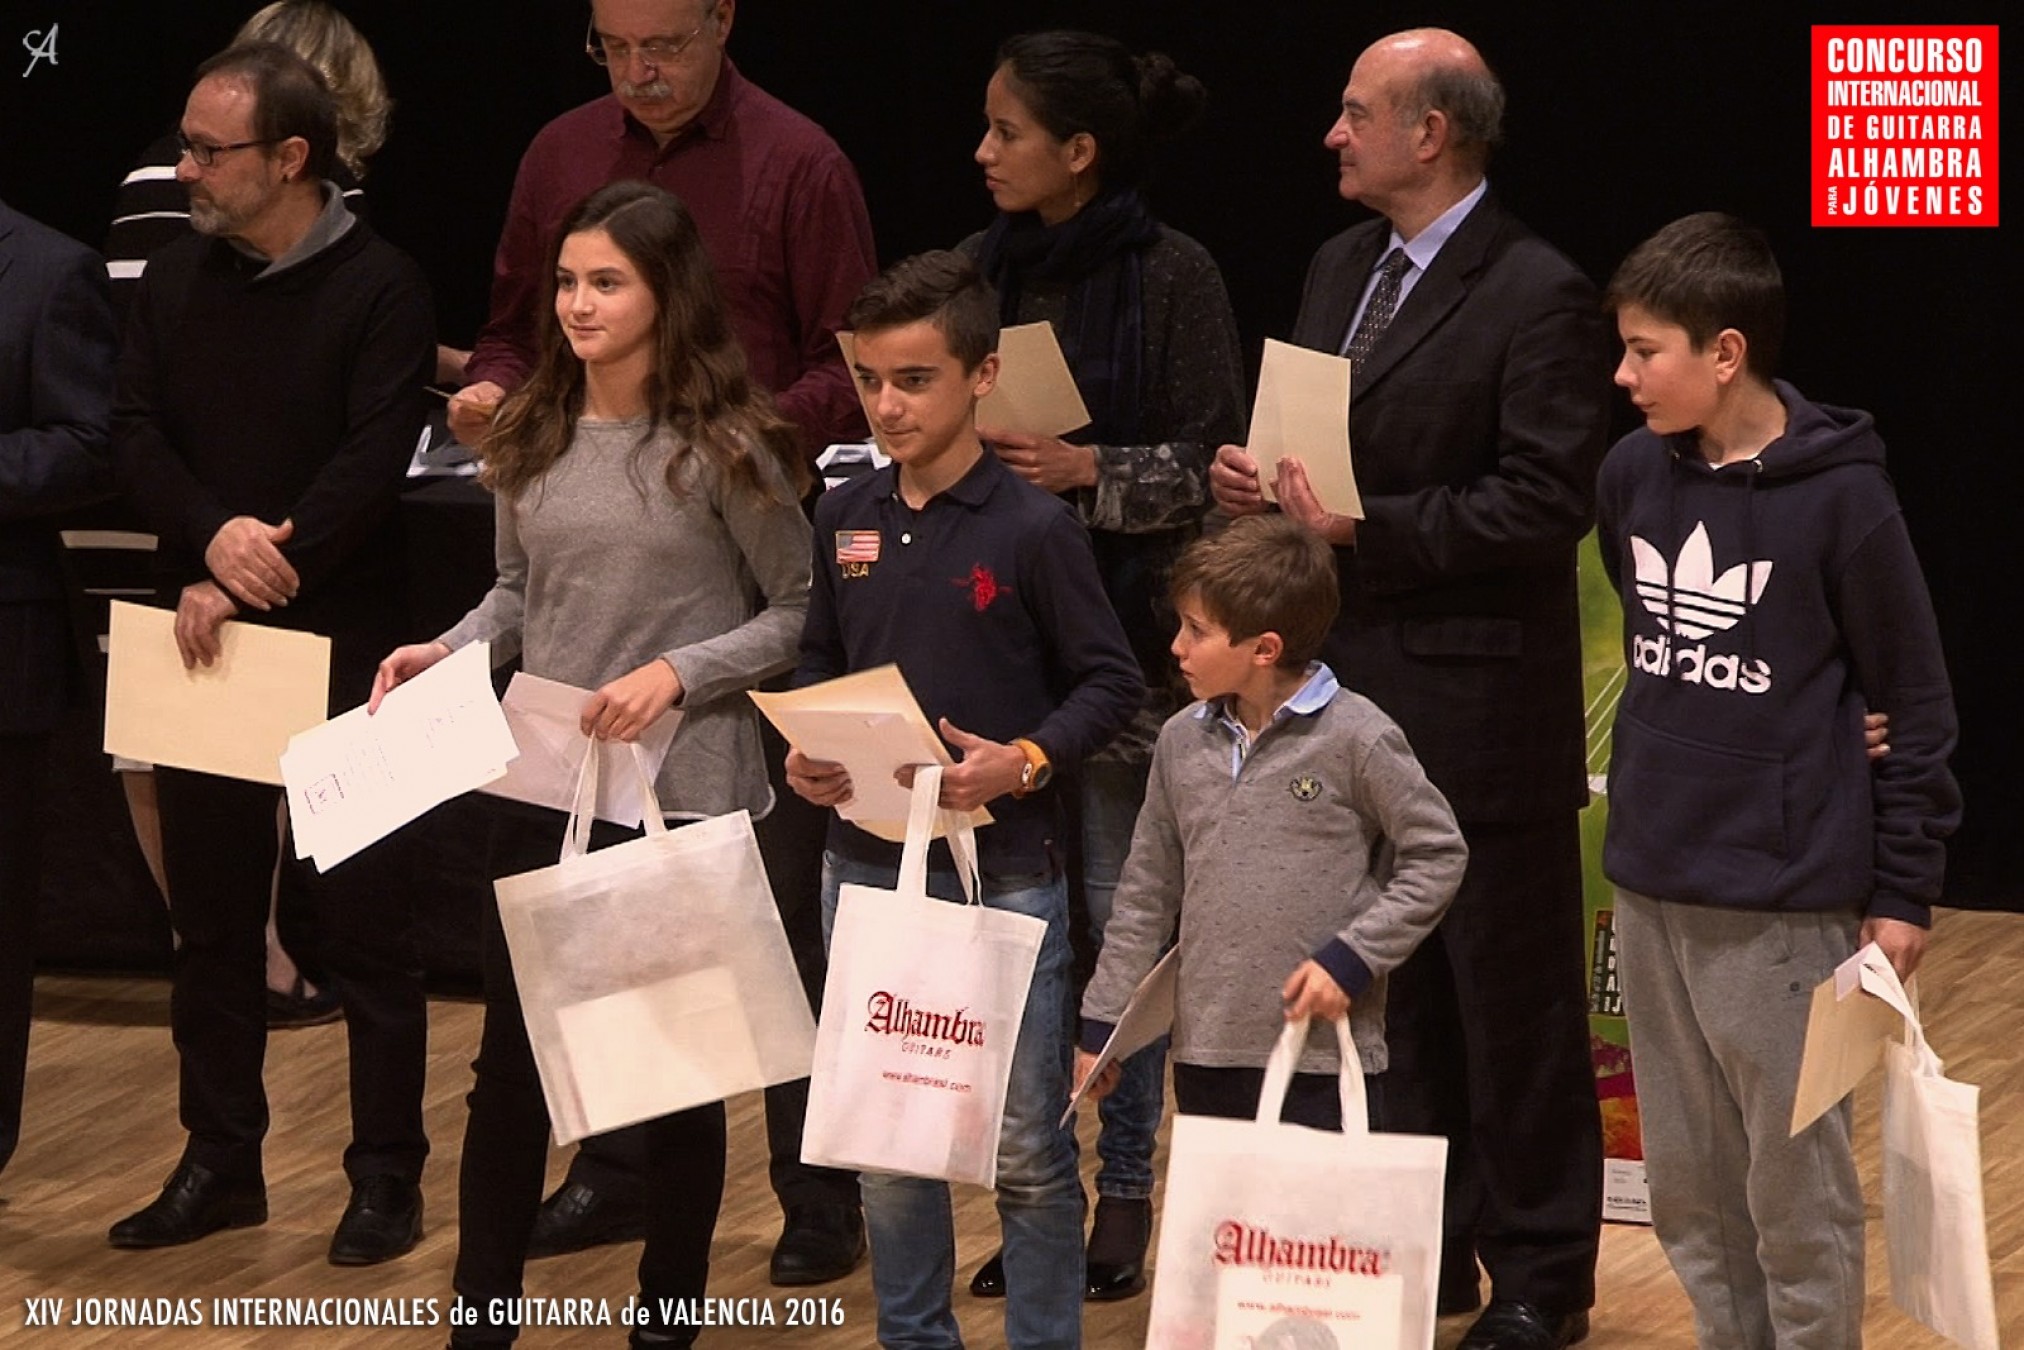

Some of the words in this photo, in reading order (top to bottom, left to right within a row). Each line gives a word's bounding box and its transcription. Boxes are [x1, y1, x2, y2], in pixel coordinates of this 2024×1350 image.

[842, 563, 870, 579] USA
[864, 990, 985, 1047] Alhambra
[1213, 1220, 1381, 1278] Alhambra
